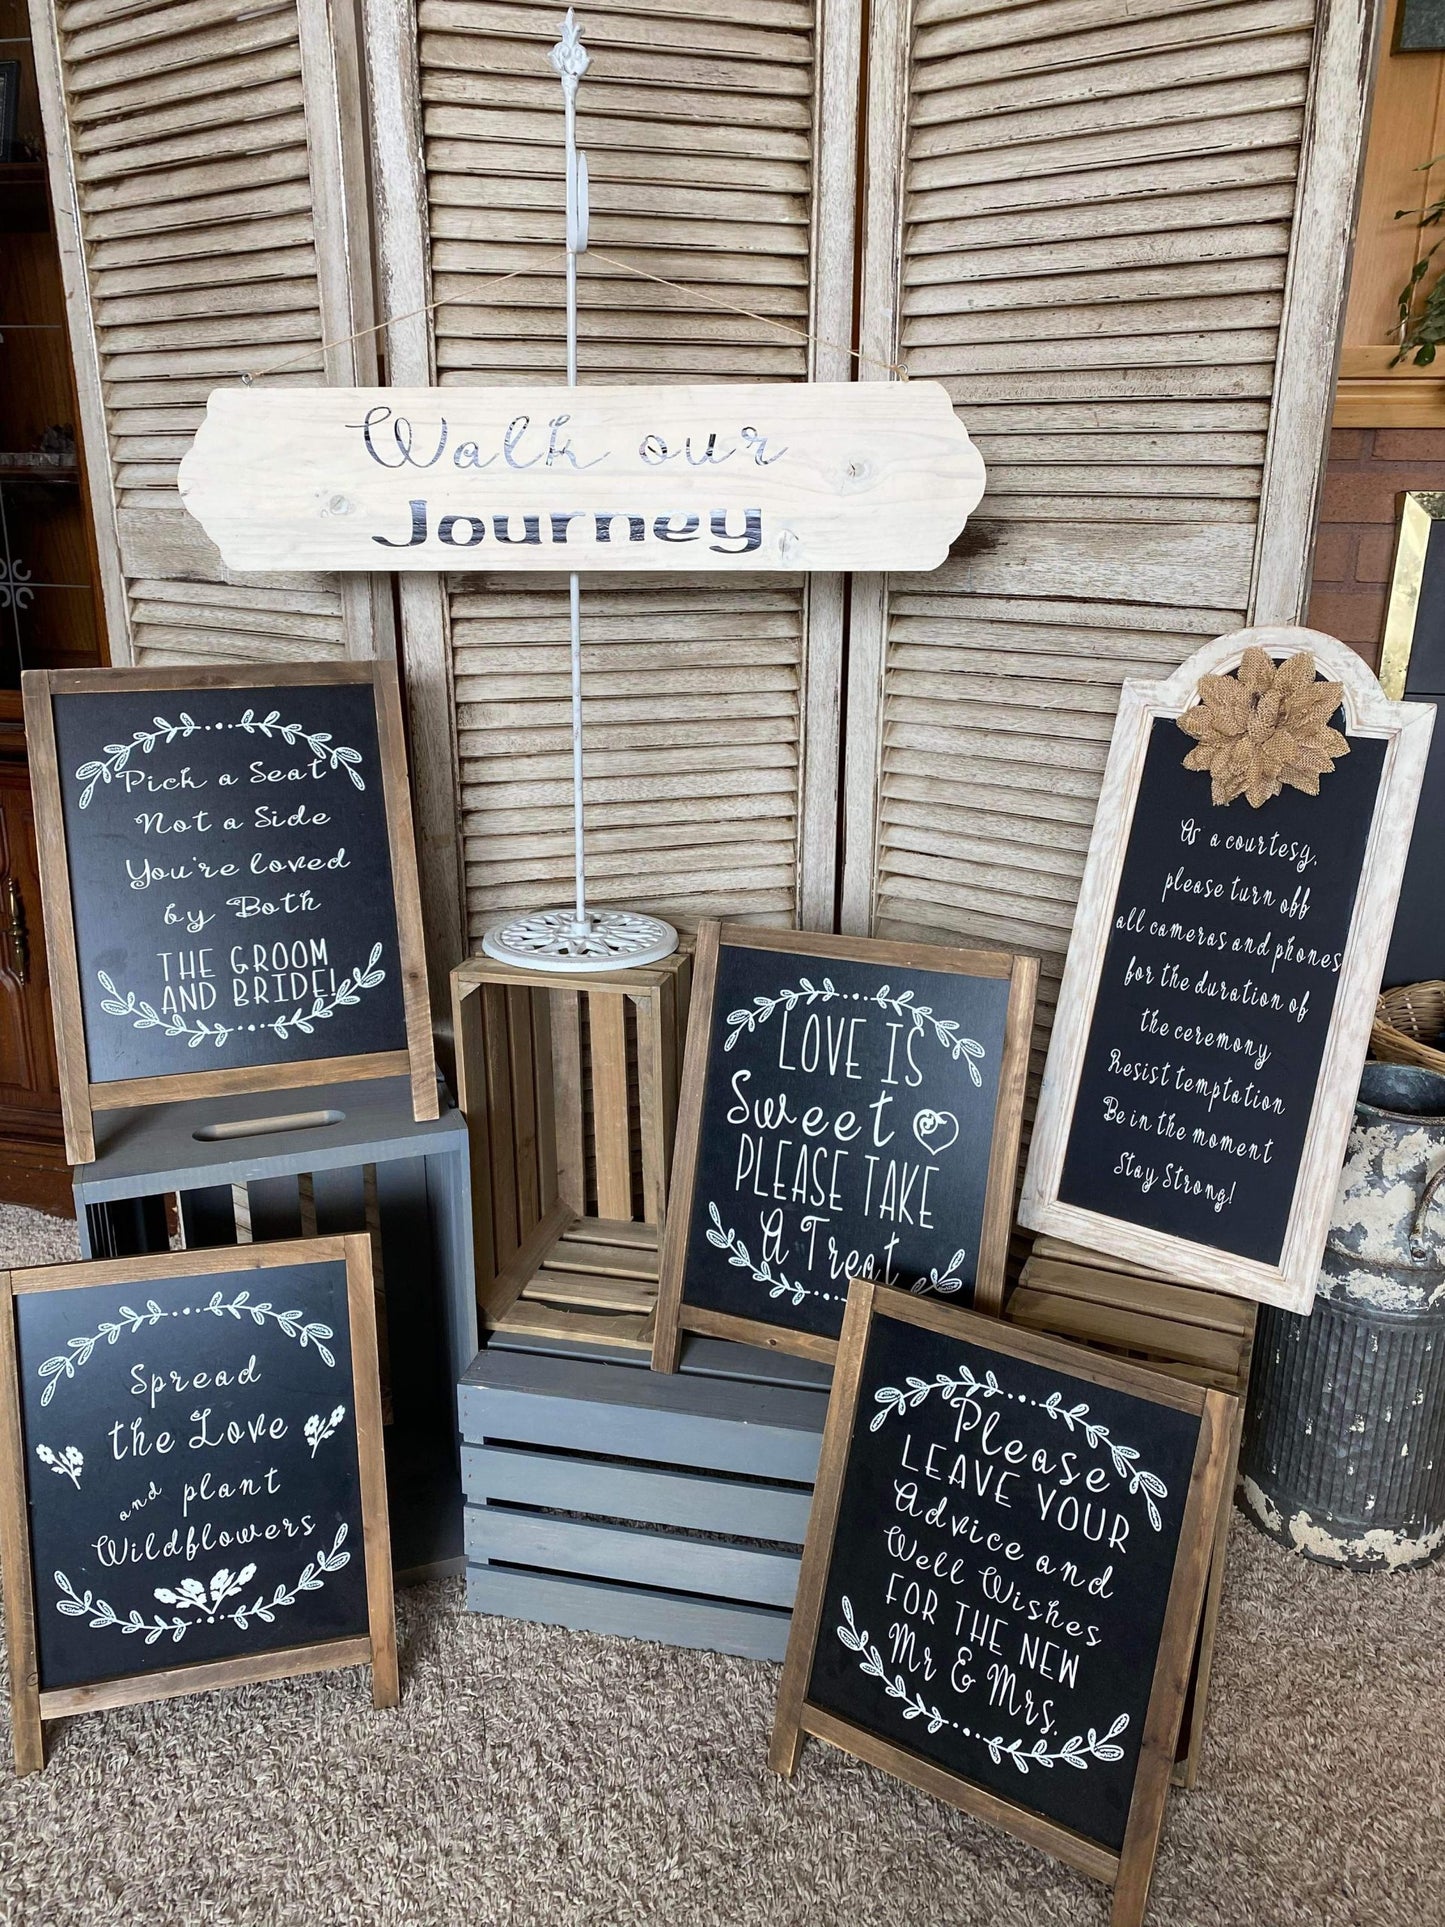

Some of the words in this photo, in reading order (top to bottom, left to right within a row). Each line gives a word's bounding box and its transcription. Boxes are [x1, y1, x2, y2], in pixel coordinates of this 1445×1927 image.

[345, 406, 611, 469] Walk
[639, 426, 788, 468] our
[371, 498, 764, 554] Journey
[116, 767, 207, 793] Pick
[218, 772, 238, 786] a
[250, 759, 327, 784] Seat
[134, 810, 212, 834] Not
[223, 817, 243, 830] a
[254, 805, 331, 828] Side
[1180, 817, 1201, 846] As
[1210, 832, 1221, 848] a
[125, 856, 240, 890] You're
[250, 848, 351, 875] loved
[1162, 866, 1224, 903] please
[1230, 876, 1276, 906] turn
[1280, 886, 1311, 920] off
[163, 903, 216, 933] by
[226, 889, 321, 918] Both
[1116, 907, 1145, 934] all
[1150, 921, 1227, 951] cameras
[1232, 929, 1271, 957] and
[1271, 935, 1342, 973] phones
[156, 948, 216, 982] THE
[230, 938, 328, 974] GROOM
[1124, 955, 1155, 986] for
[1160, 964, 1190, 991] the
[1194, 970, 1284, 1011] duration
[1289, 991, 1310, 1023] of
[161, 981, 217, 1015] AND
[233, 968, 337, 1007] BRIDE!
[779, 1010, 867, 1080] LOVE
[881, 1023, 925, 1086] IS
[1140, 1008, 1169, 1037] the
[1174, 1021, 1272, 1070] ceremony
[726, 1069, 896, 1147] Sweet
[1108, 1048, 1172, 1087] Resist
[1174, 1067, 1286, 1115] temptation
[1103, 1095, 1127, 1125] Be
[1129, 1110, 1153, 1131] in
[1157, 1111, 1186, 1141] the
[1192, 1125, 1274, 1164] moment
[736, 1133, 849, 1211] PLEASE
[864, 1155, 940, 1229] TAKE
[1113, 1152, 1159, 1193] Stay
[1163, 1162, 1237, 1213] Strong!
[760, 1208, 790, 1265] A
[130, 1354, 261, 1409] Spread
[108, 1417, 175, 1461] the
[188, 1408, 288, 1450] Love
[950, 1397, 1110, 1493] Please
[119, 1480, 163, 1522] and
[183, 1467, 281, 1517] plant
[902, 1434, 1021, 1509] LEAVE
[1037, 1483, 1130, 1554] YOUR
[91, 1514, 316, 1568] Wildflowers
[893, 1479, 1024, 1561] Advice
[1036, 1554, 1114, 1599] and
[884, 1526, 965, 1585] Well
[978, 1566, 1102, 1647] Wishes
[886, 1572, 938, 1626] FOR
[955, 1600, 1008, 1656] THE
[1020, 1632, 1079, 1689] NEW
[888, 1622, 937, 1682] Mr
[951, 1645, 976, 1694] &
[987, 1663, 1059, 1737] Mrs.
